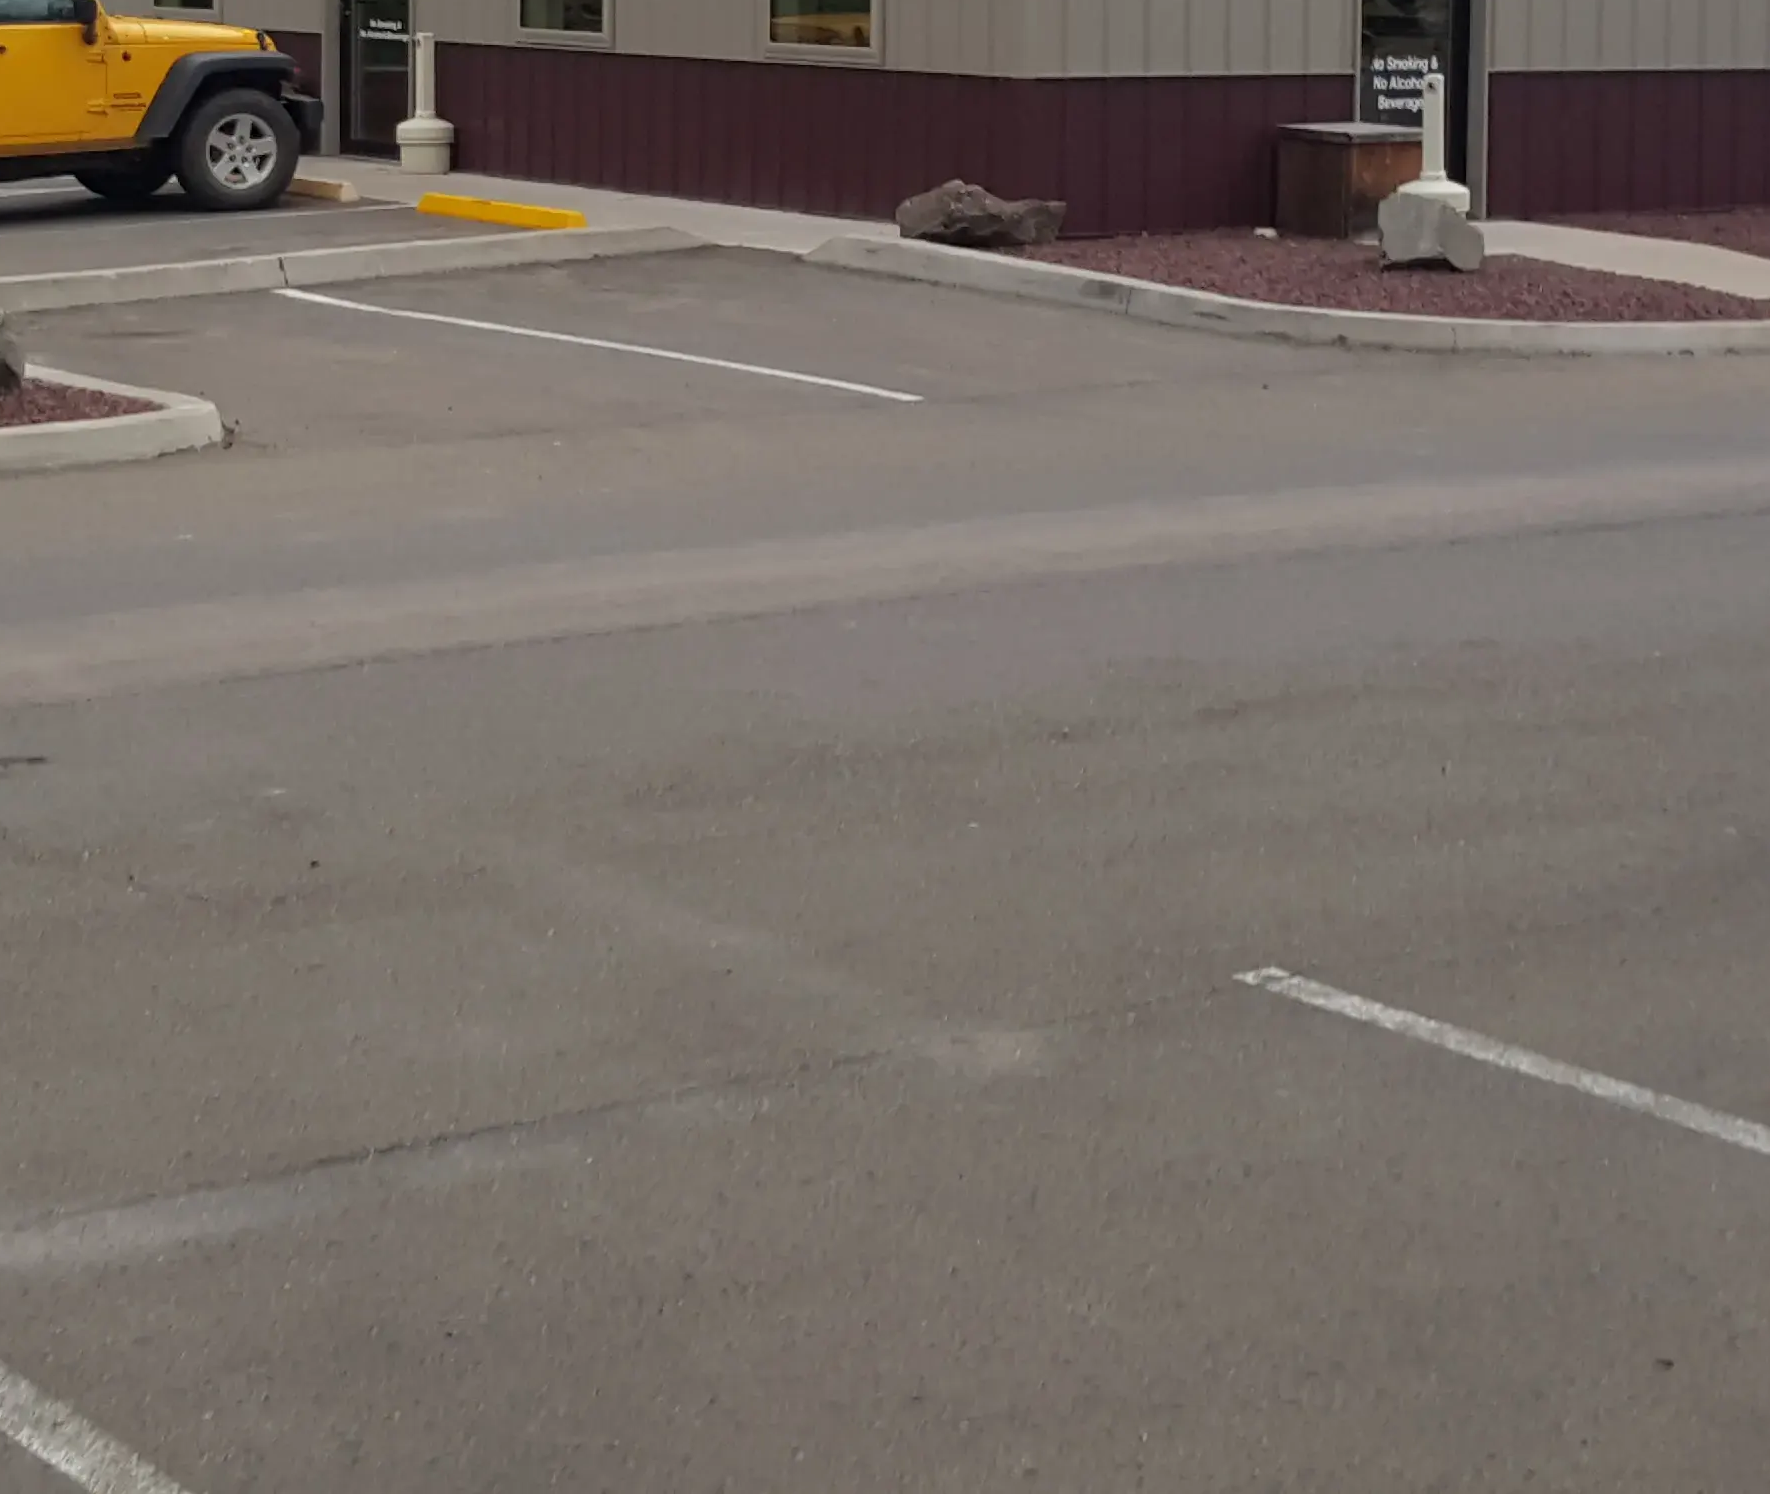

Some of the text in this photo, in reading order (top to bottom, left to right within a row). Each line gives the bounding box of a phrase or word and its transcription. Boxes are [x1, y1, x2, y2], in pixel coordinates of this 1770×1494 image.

[1386, 55, 1429, 73] Smoking
[1373, 74, 1425, 90] No Alcoho
[1377, 94, 1425, 113] Beverage
